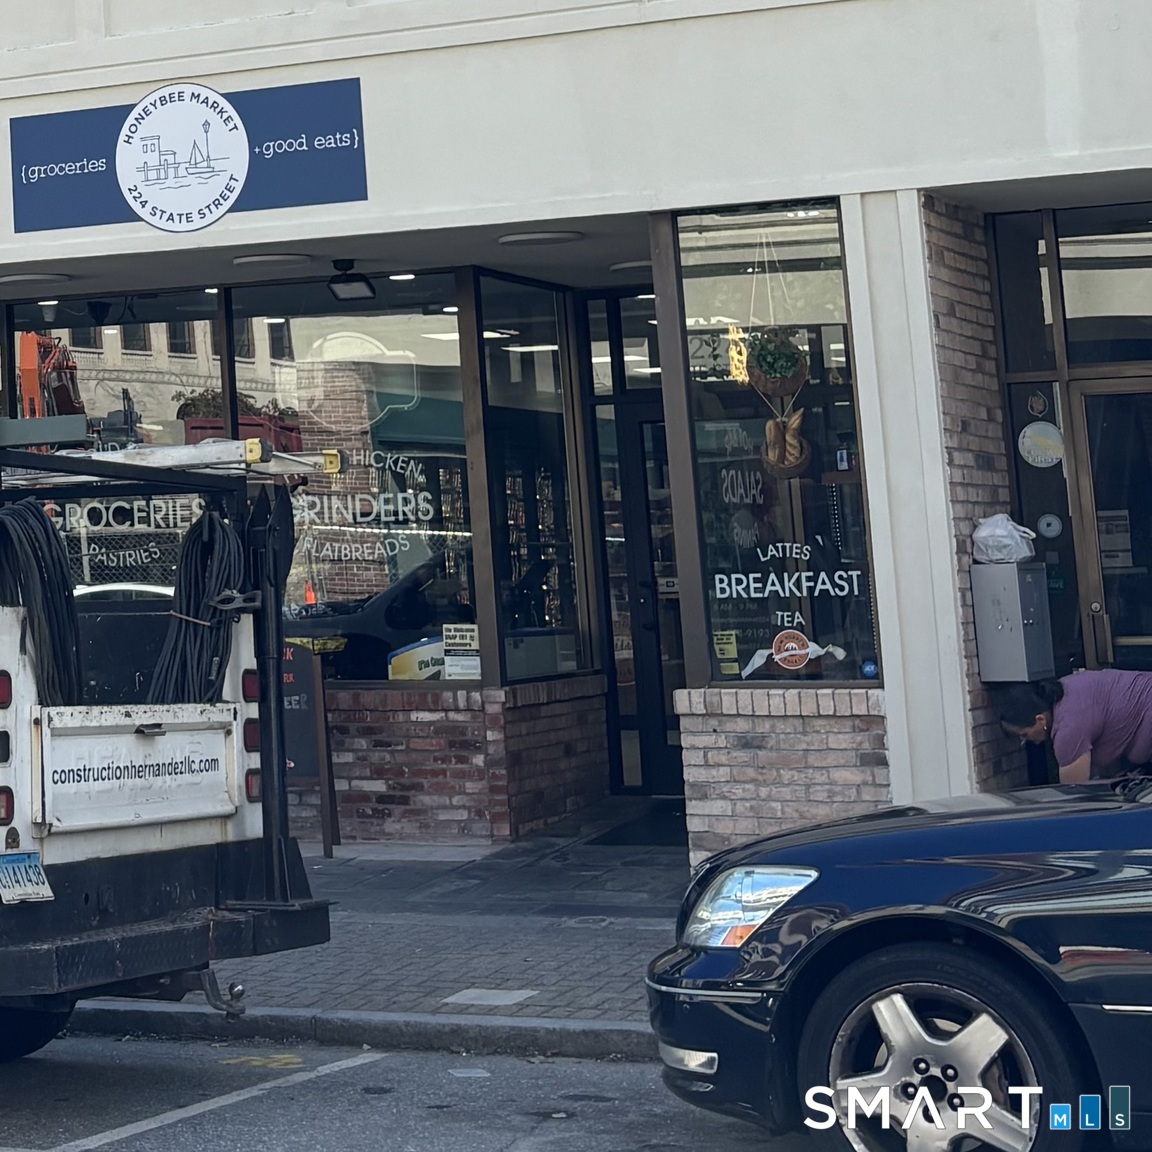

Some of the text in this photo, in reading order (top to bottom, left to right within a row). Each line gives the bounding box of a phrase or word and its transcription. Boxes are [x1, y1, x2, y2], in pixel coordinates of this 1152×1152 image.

[123, 91, 239, 144] HONEYBEE MARKET
[128, 173, 239, 224] 224 STATE STREET
[344, 449, 422, 479] HICKEN
[89, 542, 161, 567] PASTRIES
[303, 534, 410, 560] FLATBREADS
[757, 542, 811, 561] LATTES
[714, 570, 861, 598] BREAKFAST
[775, 611, 806, 626] TEA
[51, 755, 219, 785] constructionhernandezllc.com
